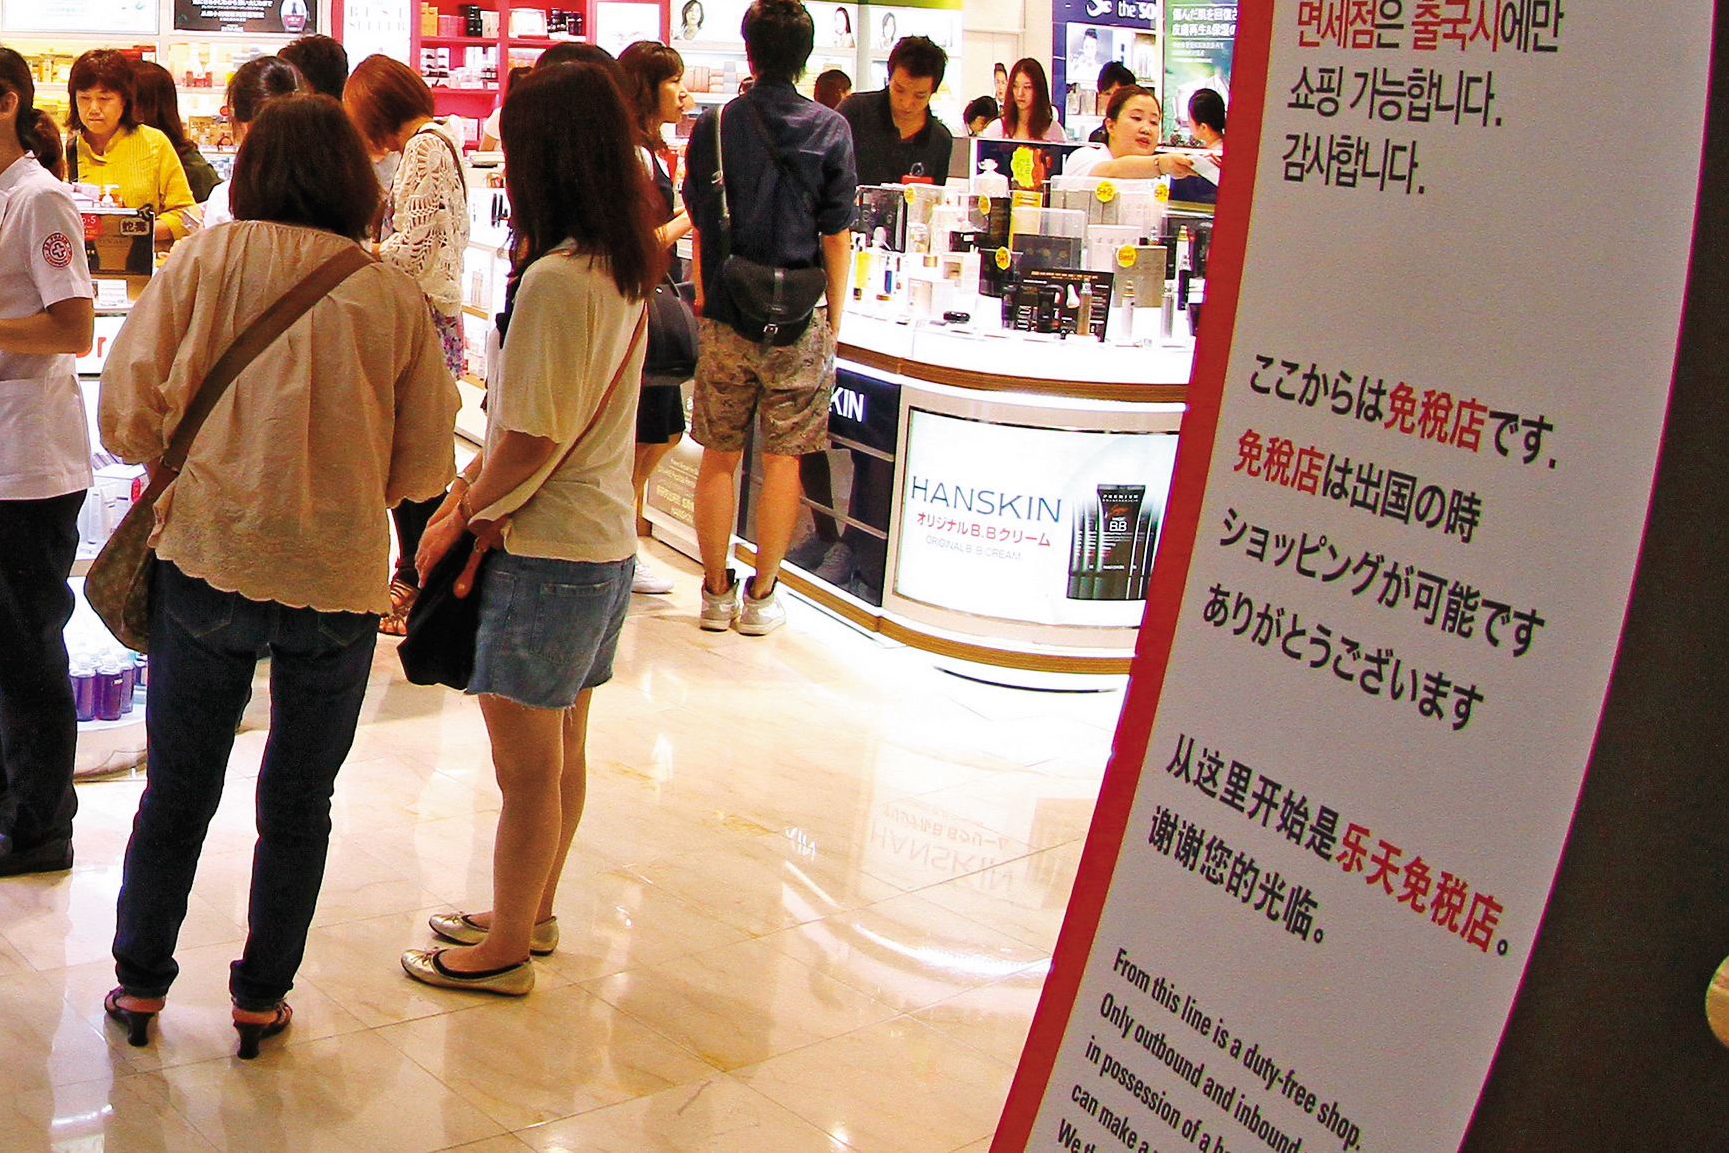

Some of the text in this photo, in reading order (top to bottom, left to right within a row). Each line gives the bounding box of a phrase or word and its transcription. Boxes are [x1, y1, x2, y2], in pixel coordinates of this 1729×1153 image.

[1118, 0, 1136, 18] the
[1287, 64, 1503, 128] 쇼핑 가능합니다.
[1281, 133, 1426, 196] 감사합니다.
[911, 476, 1061, 523] HANSKIN
[926, 535, 964, 552] ORIGINAL
[1219, 507, 1545, 658] ショッピングが可能です
[1202, 583, 1485, 731] ありがとうございます
[1147, 805, 1324, 944] 谢谢您的光临。
[1166, 733, 1509, 955] 从这里开始是乐天免税店。
[1085, 1035, 1100, 1064] in
[1100, 1054, 1181, 1129] possession
[1182, 1119, 1203, 1143] of
[1199, 1133, 1211, 1153] a
[1100, 993, 1302, 1153] Only outbound and inbound
[1113, 948, 1360, 1151] From this line is a duty-free shop.
[1058, 1118, 1081, 1153] We
[1071, 1084, 1098, 1116] can
[1098, 1106, 1138, 1149] make
